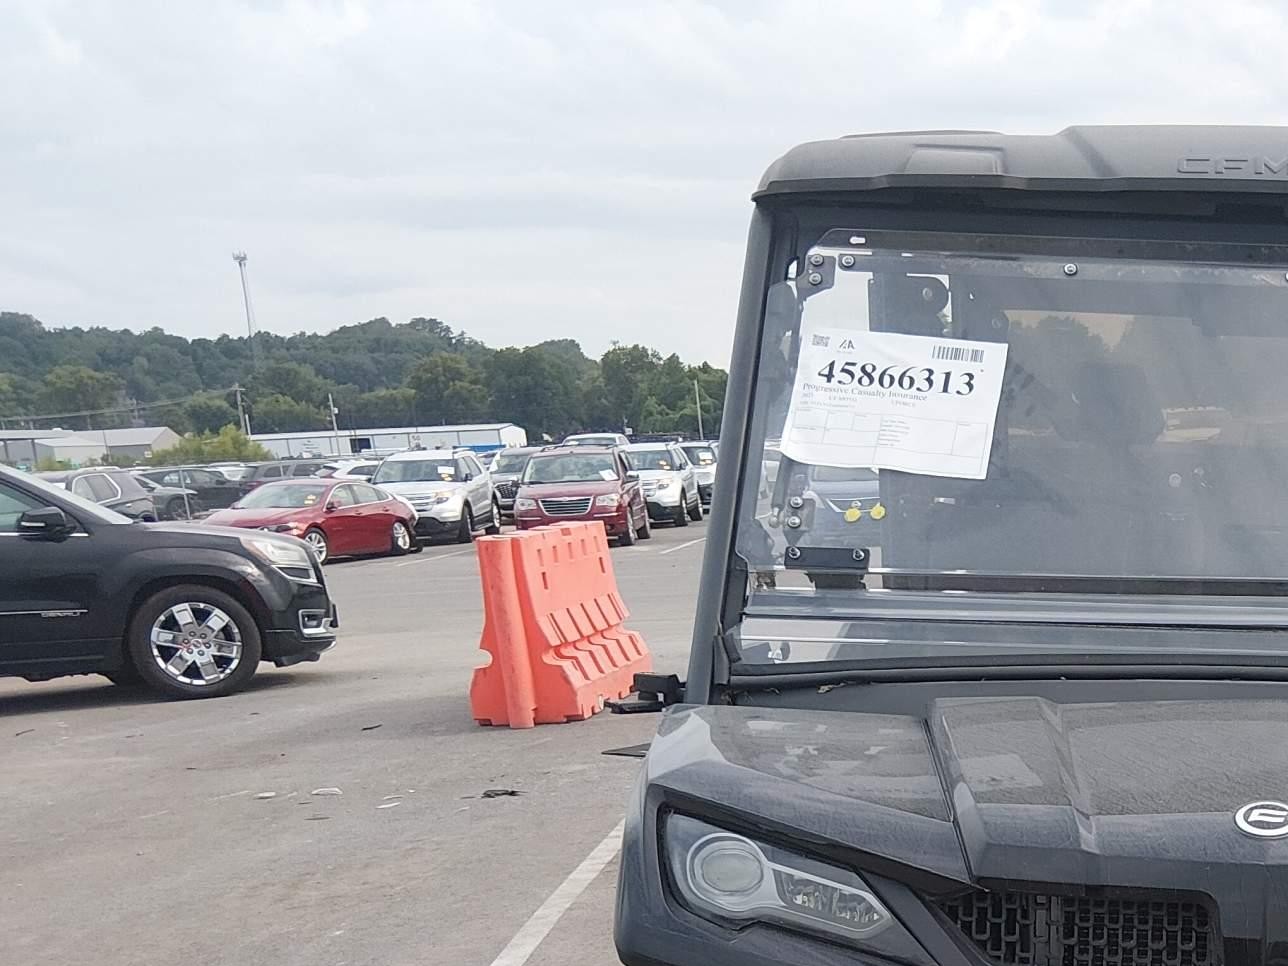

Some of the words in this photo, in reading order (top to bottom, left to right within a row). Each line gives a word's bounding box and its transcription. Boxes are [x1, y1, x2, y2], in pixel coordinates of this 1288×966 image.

[802, 382, 850, 395] Progressive
[851, 387, 886, 399] Casualty
[888, 390, 929, 401] Insurance
[817, 359, 976, 396] 45866313
